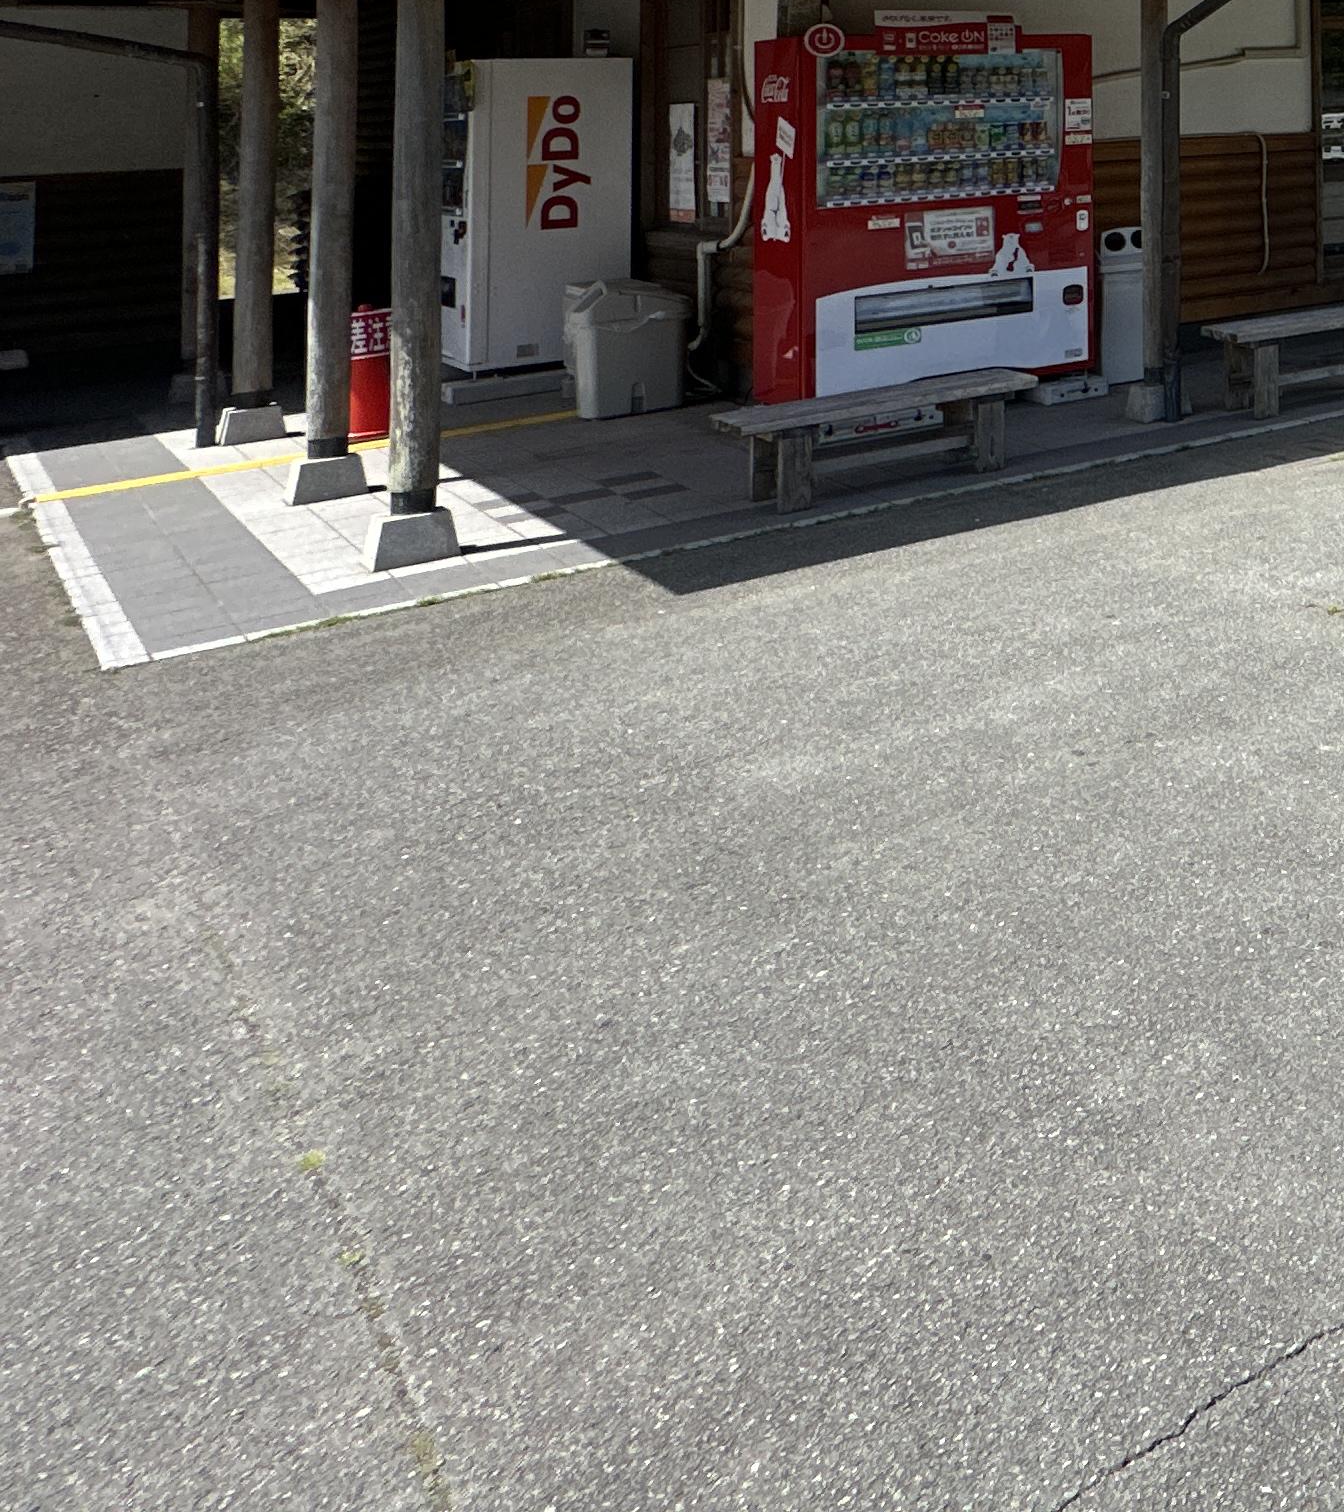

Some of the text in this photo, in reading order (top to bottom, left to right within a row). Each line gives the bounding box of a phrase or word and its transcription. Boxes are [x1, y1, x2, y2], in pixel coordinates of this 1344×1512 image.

[918, 28, 985, 43] Coke ON
[541, 95, 591, 229] DyDo
